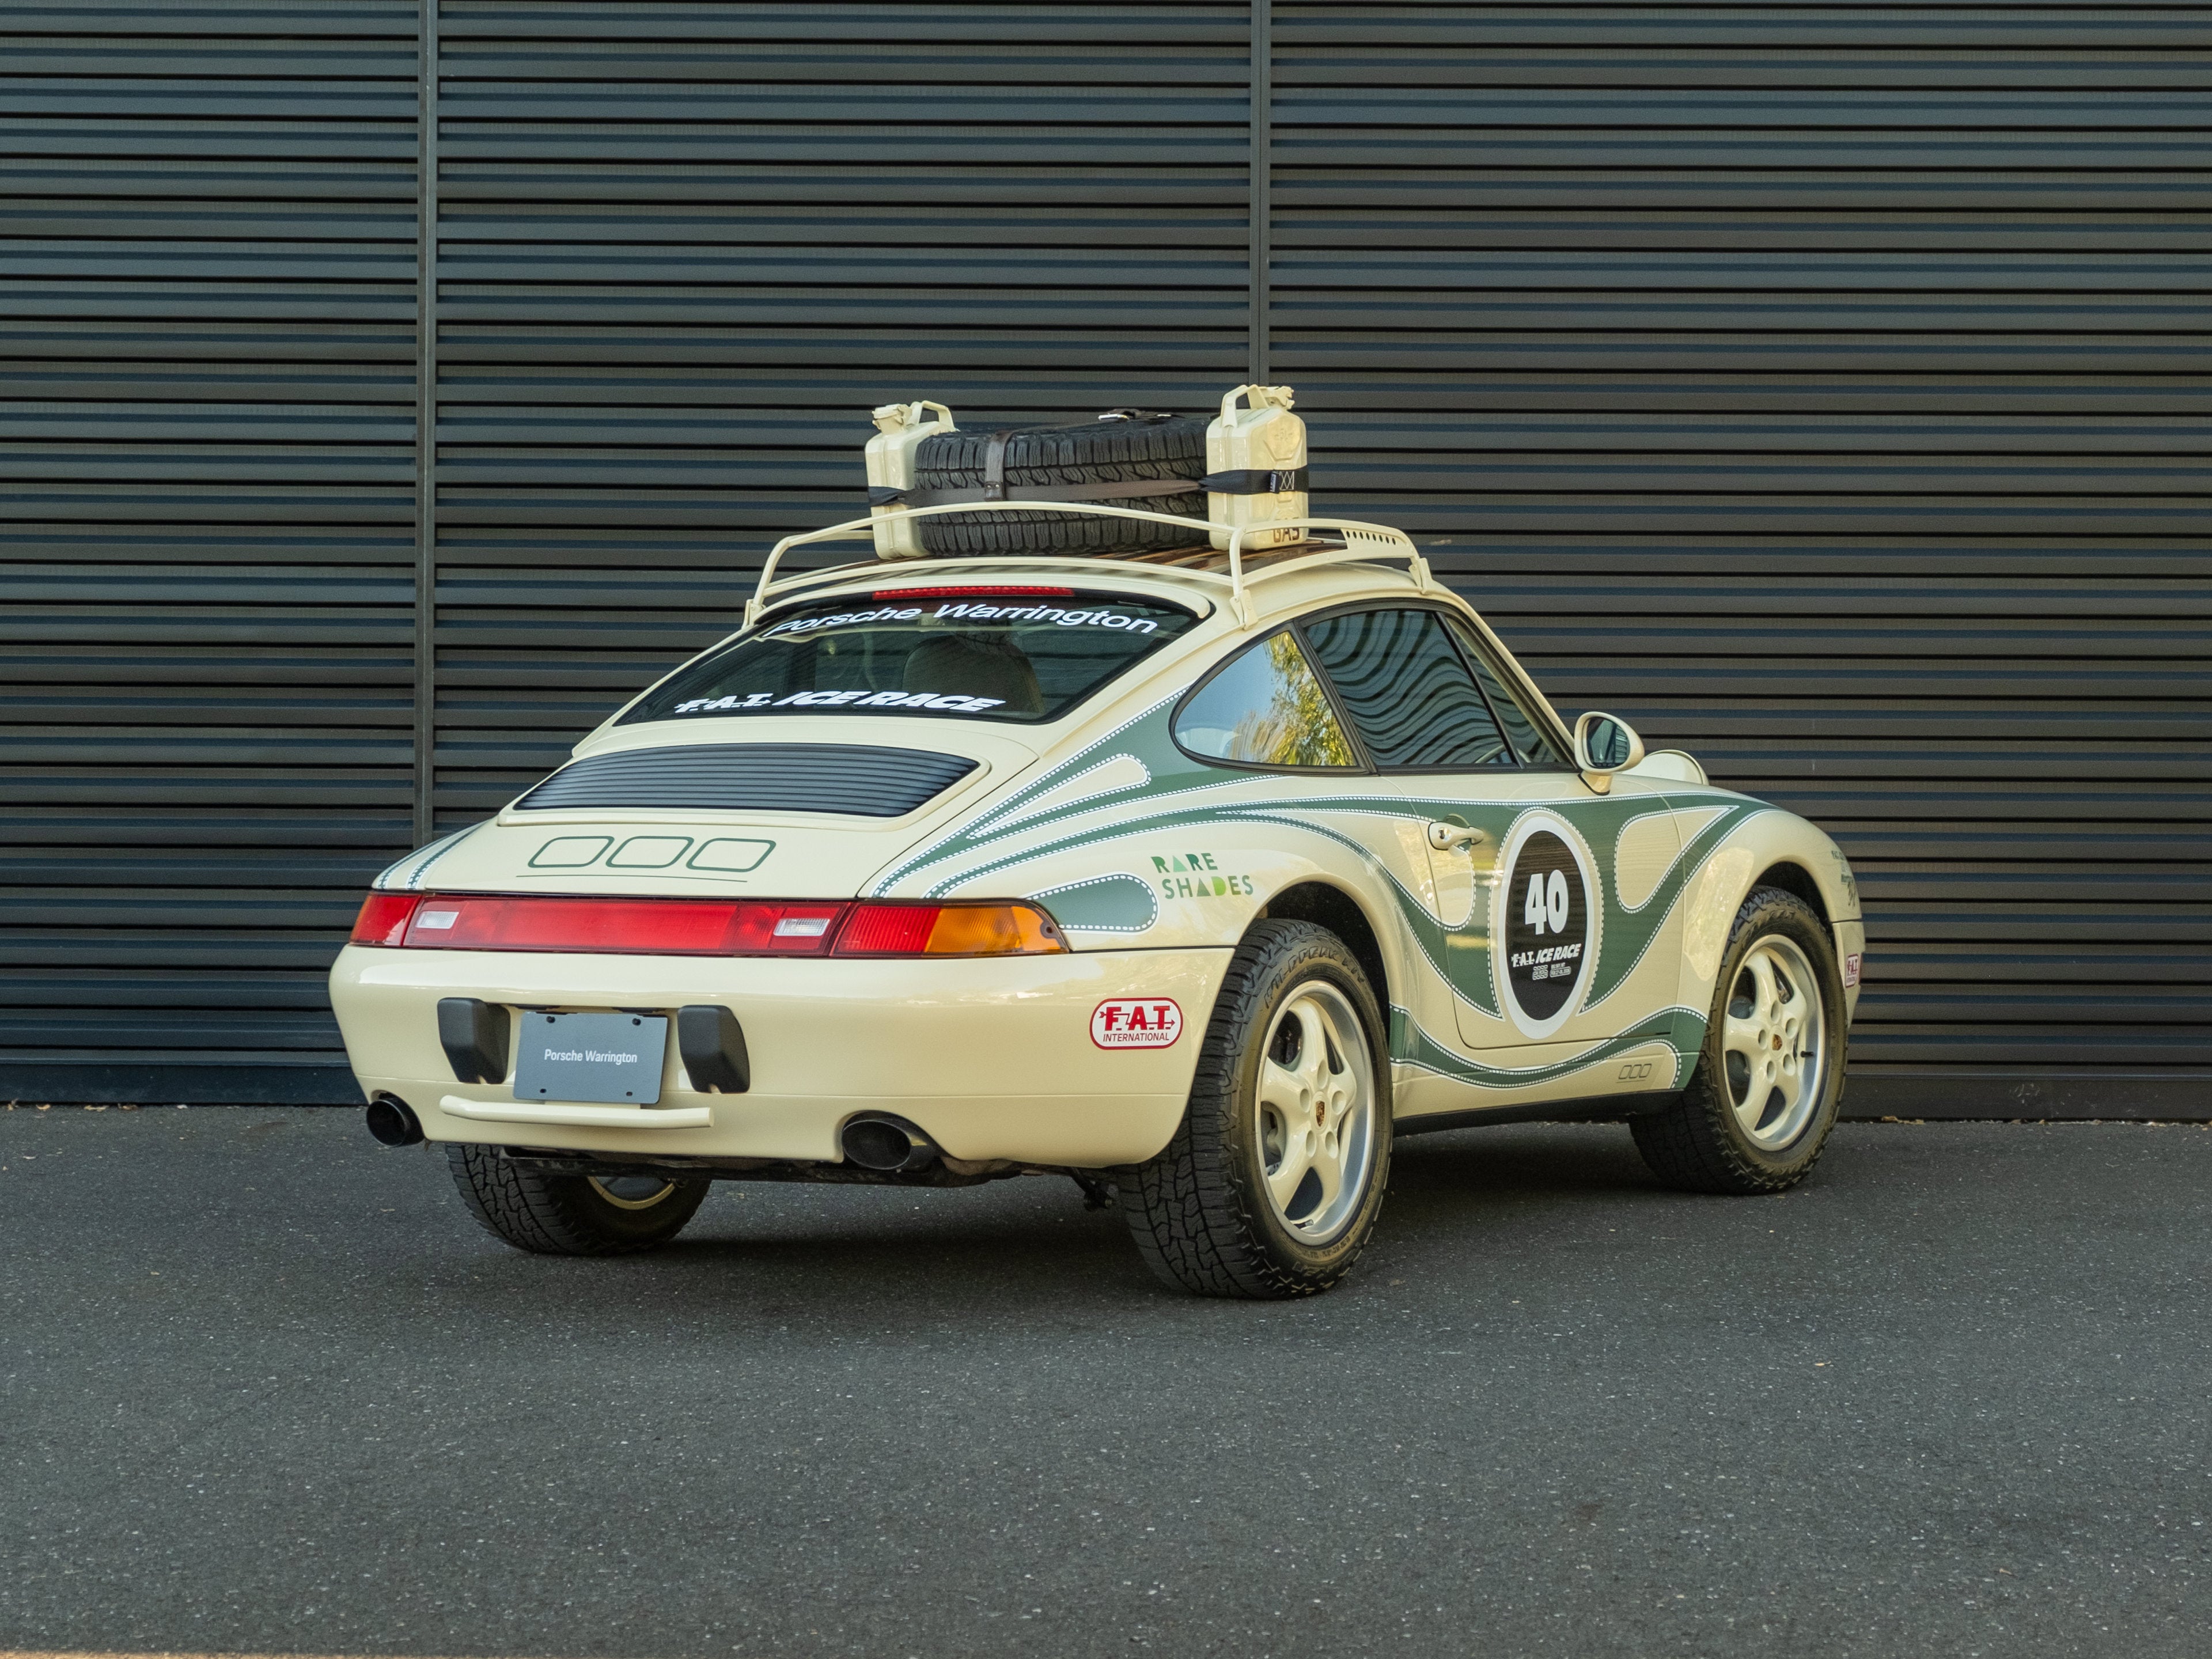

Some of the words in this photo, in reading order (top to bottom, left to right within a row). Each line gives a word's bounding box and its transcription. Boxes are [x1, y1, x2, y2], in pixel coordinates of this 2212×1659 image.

[762, 607, 922, 638] Porsche
[933, 604, 1158, 634] Warrington
[774, 691, 871, 707] ICE
[861, 691, 1006, 712] RACE
[1150, 853, 1218, 873] RARE
[1162, 874, 1254, 899] SHADES
[1524, 869, 1569, 935] 40
[1535, 948, 1555, 964] ICE
[1552, 943, 1582, 961] RACE
[1103, 1005, 1172, 1031] F.A.T.
[1103, 1032, 1170, 1042] INTERNATIONAL
[544, 1048, 583, 1062] Porsche
[585, 1050, 638, 1065] Warrington
